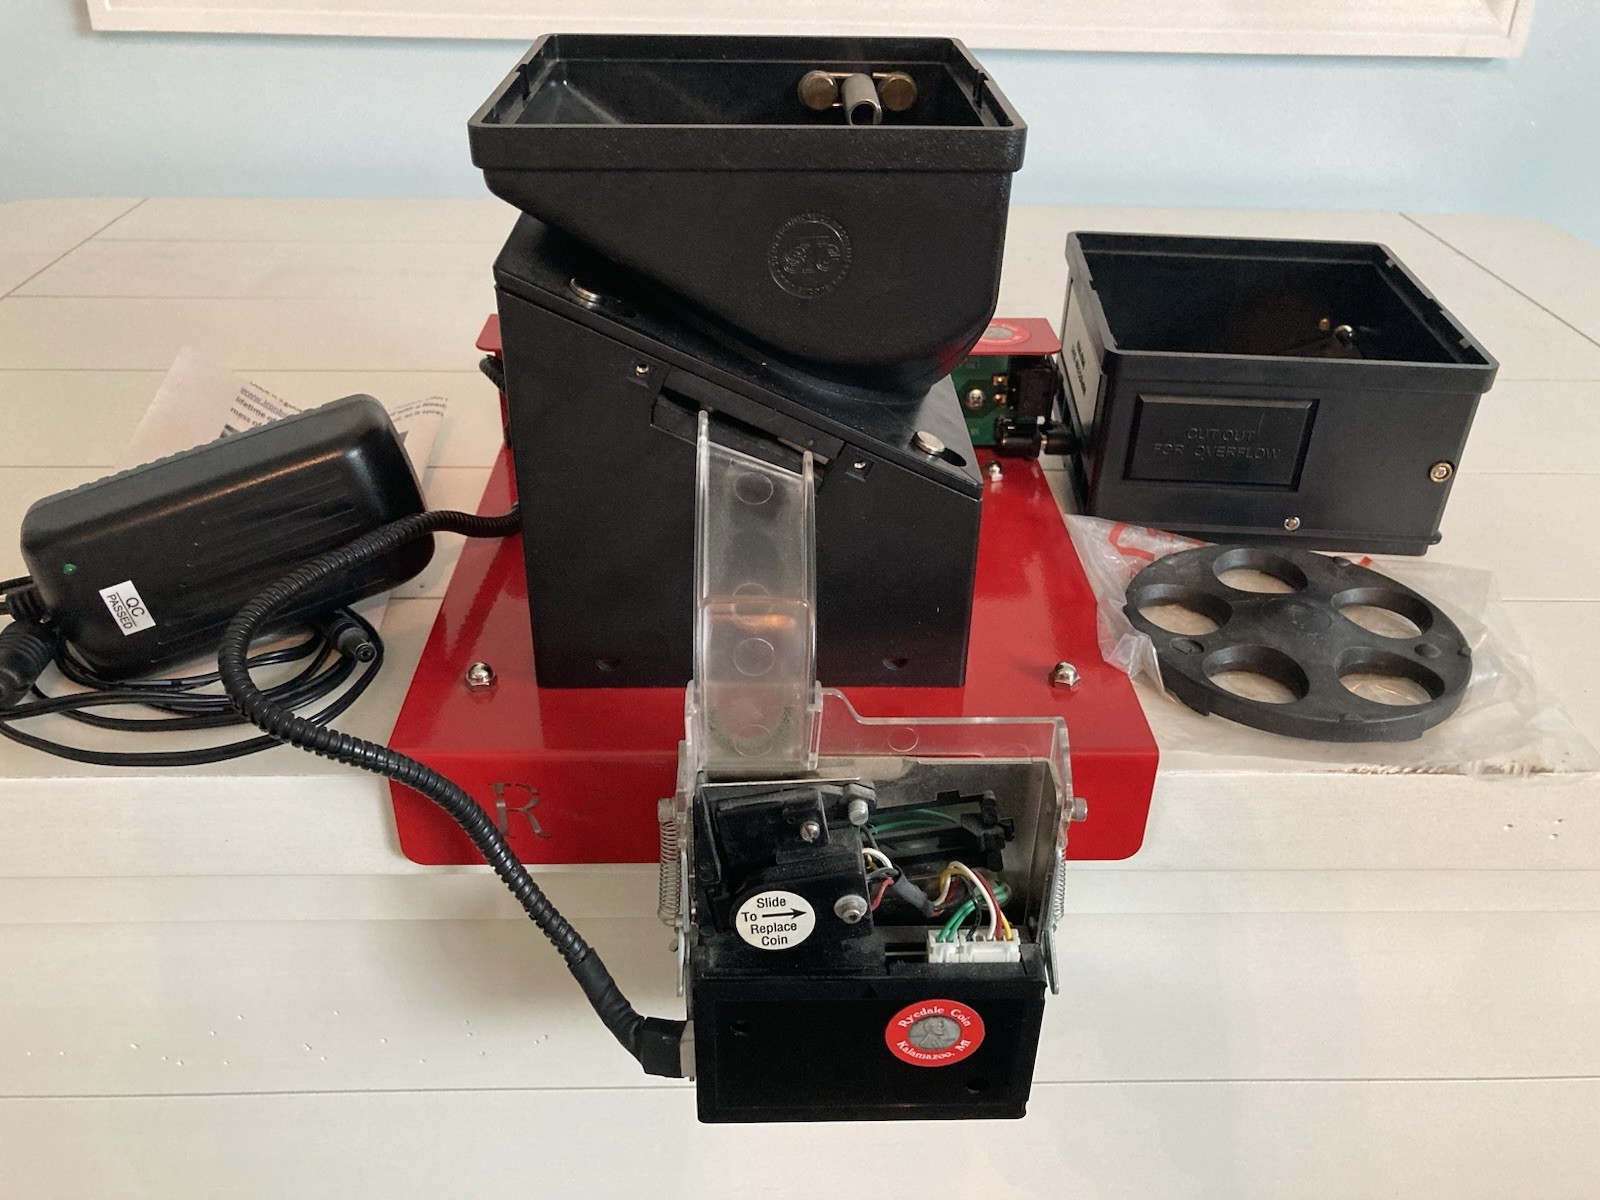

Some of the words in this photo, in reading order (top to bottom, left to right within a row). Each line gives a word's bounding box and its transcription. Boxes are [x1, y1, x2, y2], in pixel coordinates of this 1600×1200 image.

[230, 407, 252, 423] mess
[235, 396, 266, 418] lifetime
[1186, 427, 1220, 440] CUT
[1222, 428, 1256, 442] OUT
[1152, 442, 1185, 456] FOR
[1193, 445, 1282, 459] OVERFLOW
[107, 594, 132, 629] PASSED
[125, 597, 145, 617] QC
[488, 782, 552, 839] R
[756, 896, 786, 908] Slide
[741, 911, 757, 922] To
[750, 922, 797, 935] Replace
[761, 935, 788, 946] Coin
[897, 1006, 945, 1028] Ryedale
[950, 1008, 972, 1028] Coin
[896, 1040, 955, 1060] Kalamazoo,
[954, 1039, 972, 1052] MI
